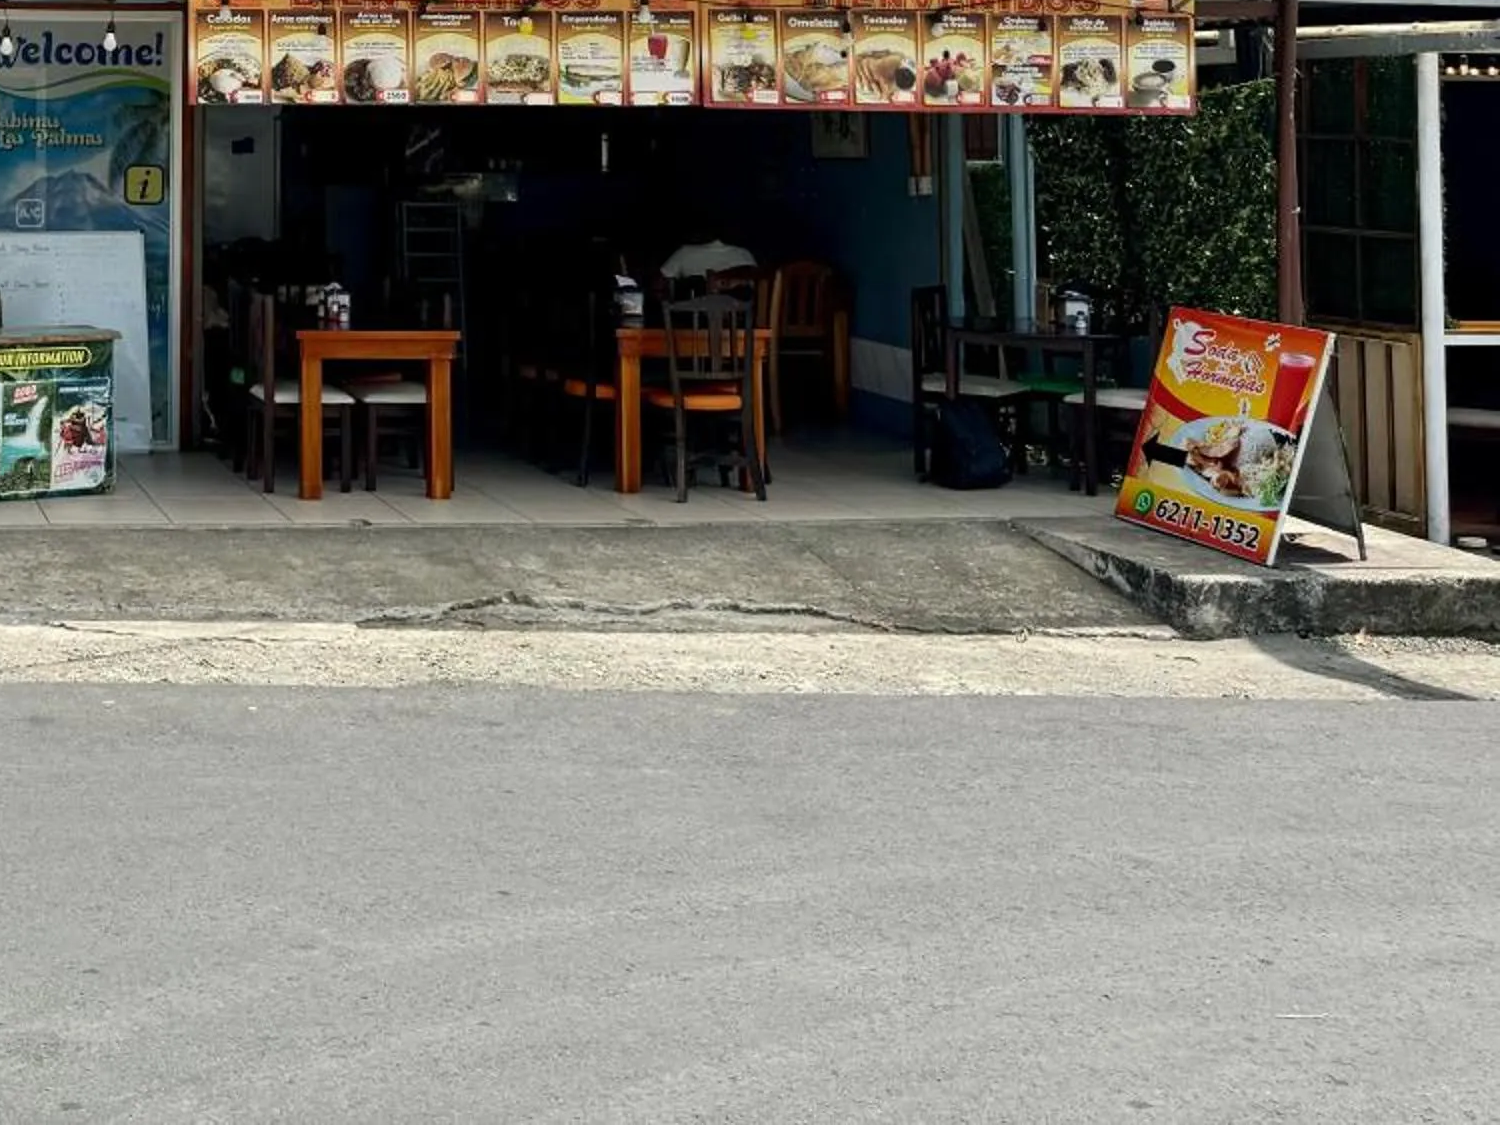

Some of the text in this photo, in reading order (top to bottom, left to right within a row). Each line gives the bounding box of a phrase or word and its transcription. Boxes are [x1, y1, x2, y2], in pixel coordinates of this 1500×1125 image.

[15, 349, 84, 366] INFORMATION
[1183, 329, 1239, 363] Soda
[1183, 360, 1266, 396] Hormigas
[1155, 498, 1261, 549] 6211-1352
